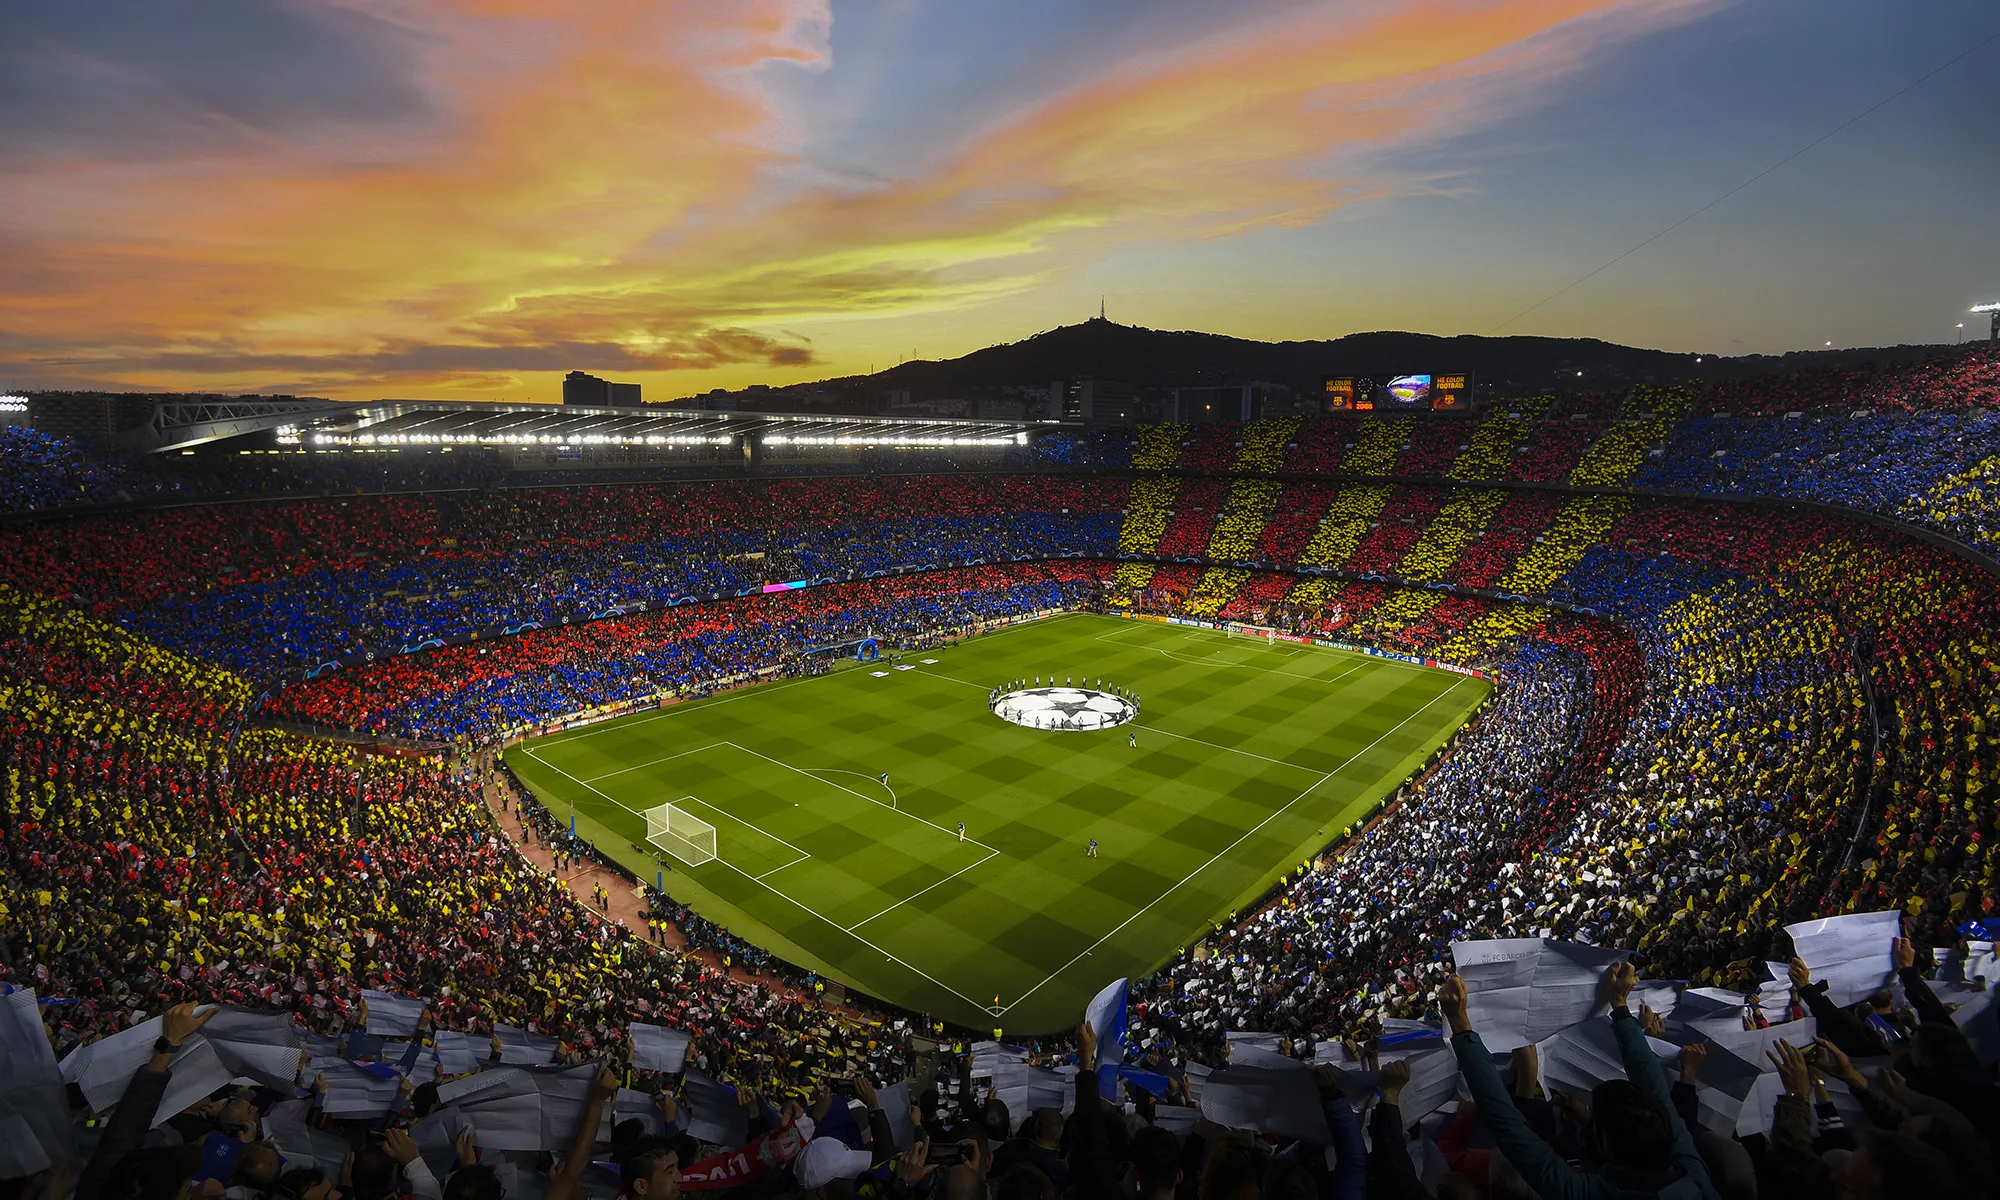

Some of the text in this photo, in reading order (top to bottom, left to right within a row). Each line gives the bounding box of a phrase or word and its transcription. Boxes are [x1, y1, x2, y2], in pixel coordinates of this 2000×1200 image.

[1272, 631, 1304, 643] Santander
[1315, 639, 1353, 651] Heineken
[1386, 652, 1409, 662] PS4
[1436, 661, 1474, 676] NISSAN
